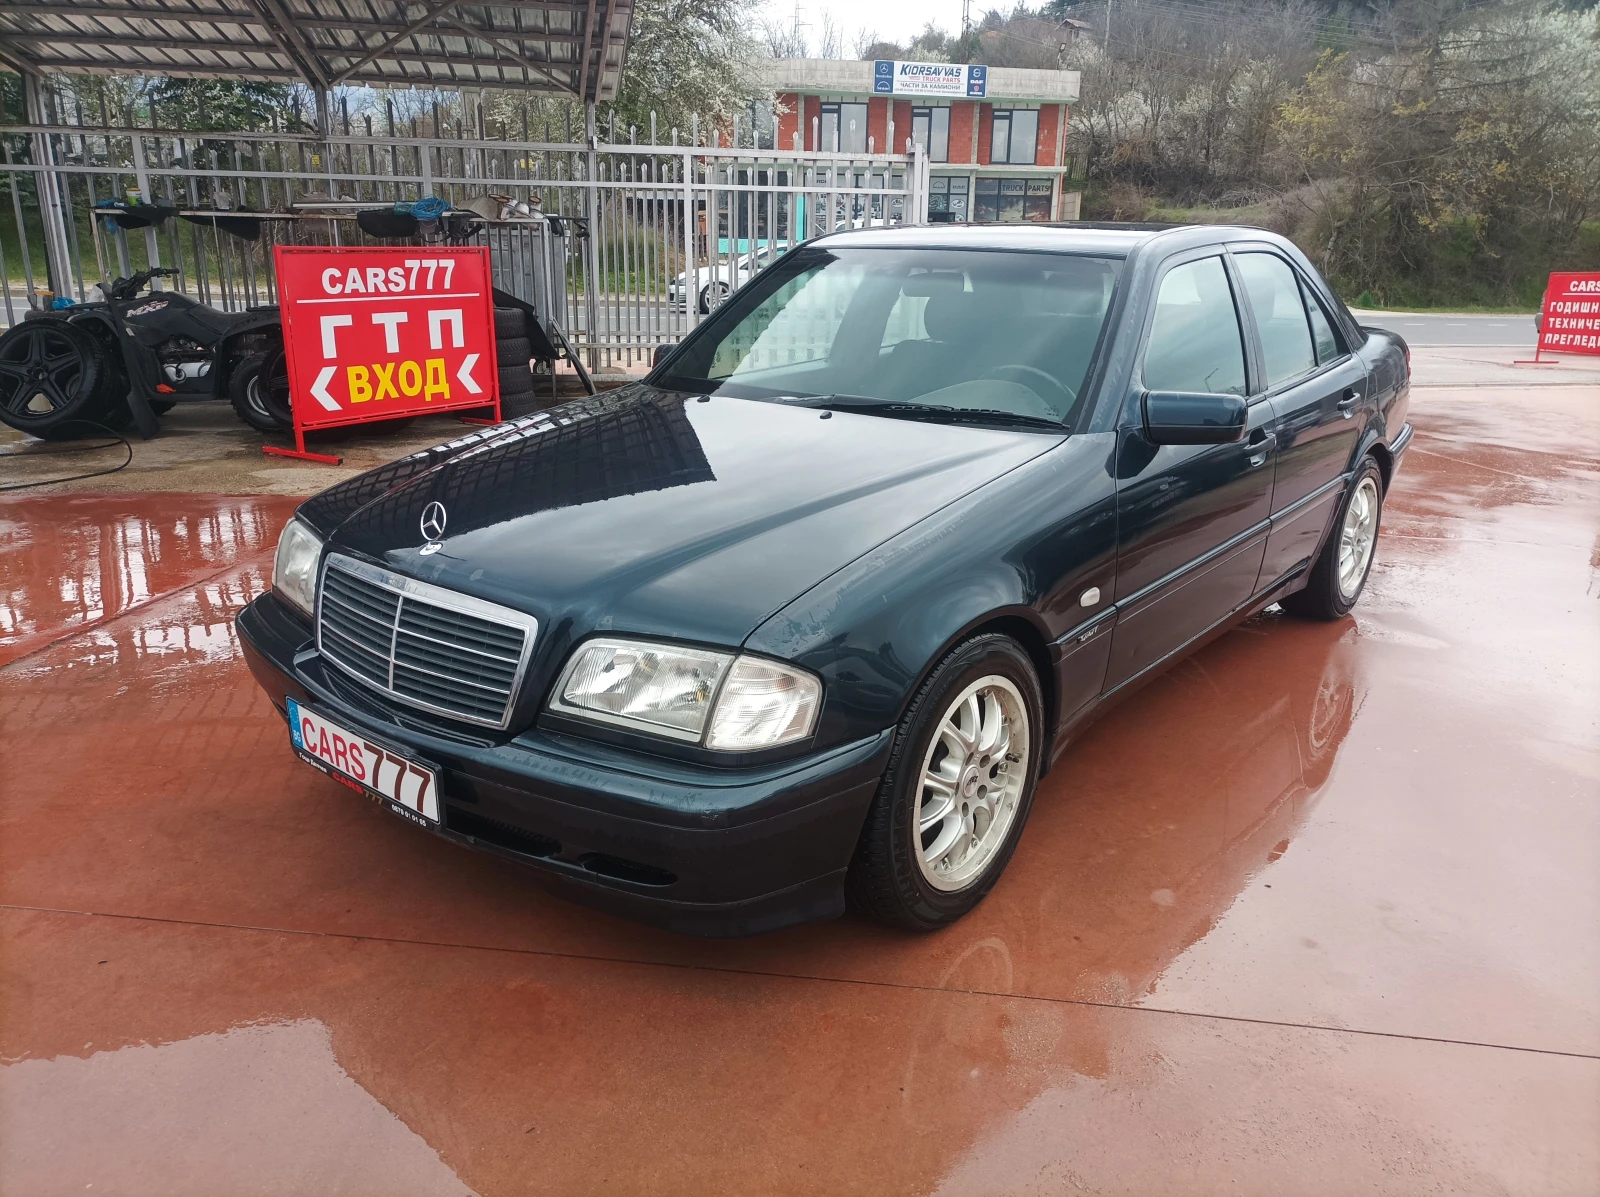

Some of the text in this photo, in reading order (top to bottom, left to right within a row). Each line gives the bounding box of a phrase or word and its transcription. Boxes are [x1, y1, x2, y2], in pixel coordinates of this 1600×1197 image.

[900, 64, 961, 77] KIORSAVVAS
[1002, 184, 1024, 192] TRUCK
[322, 259, 455, 294] CARS777
[1549, 301, 1600, 315] ГОДИШН
[347, 358, 450, 403] ВХОД
[293, 730, 301, 743] BG
[302, 717, 431, 814] CARS777
[332, 772, 383, 805] CARS777
